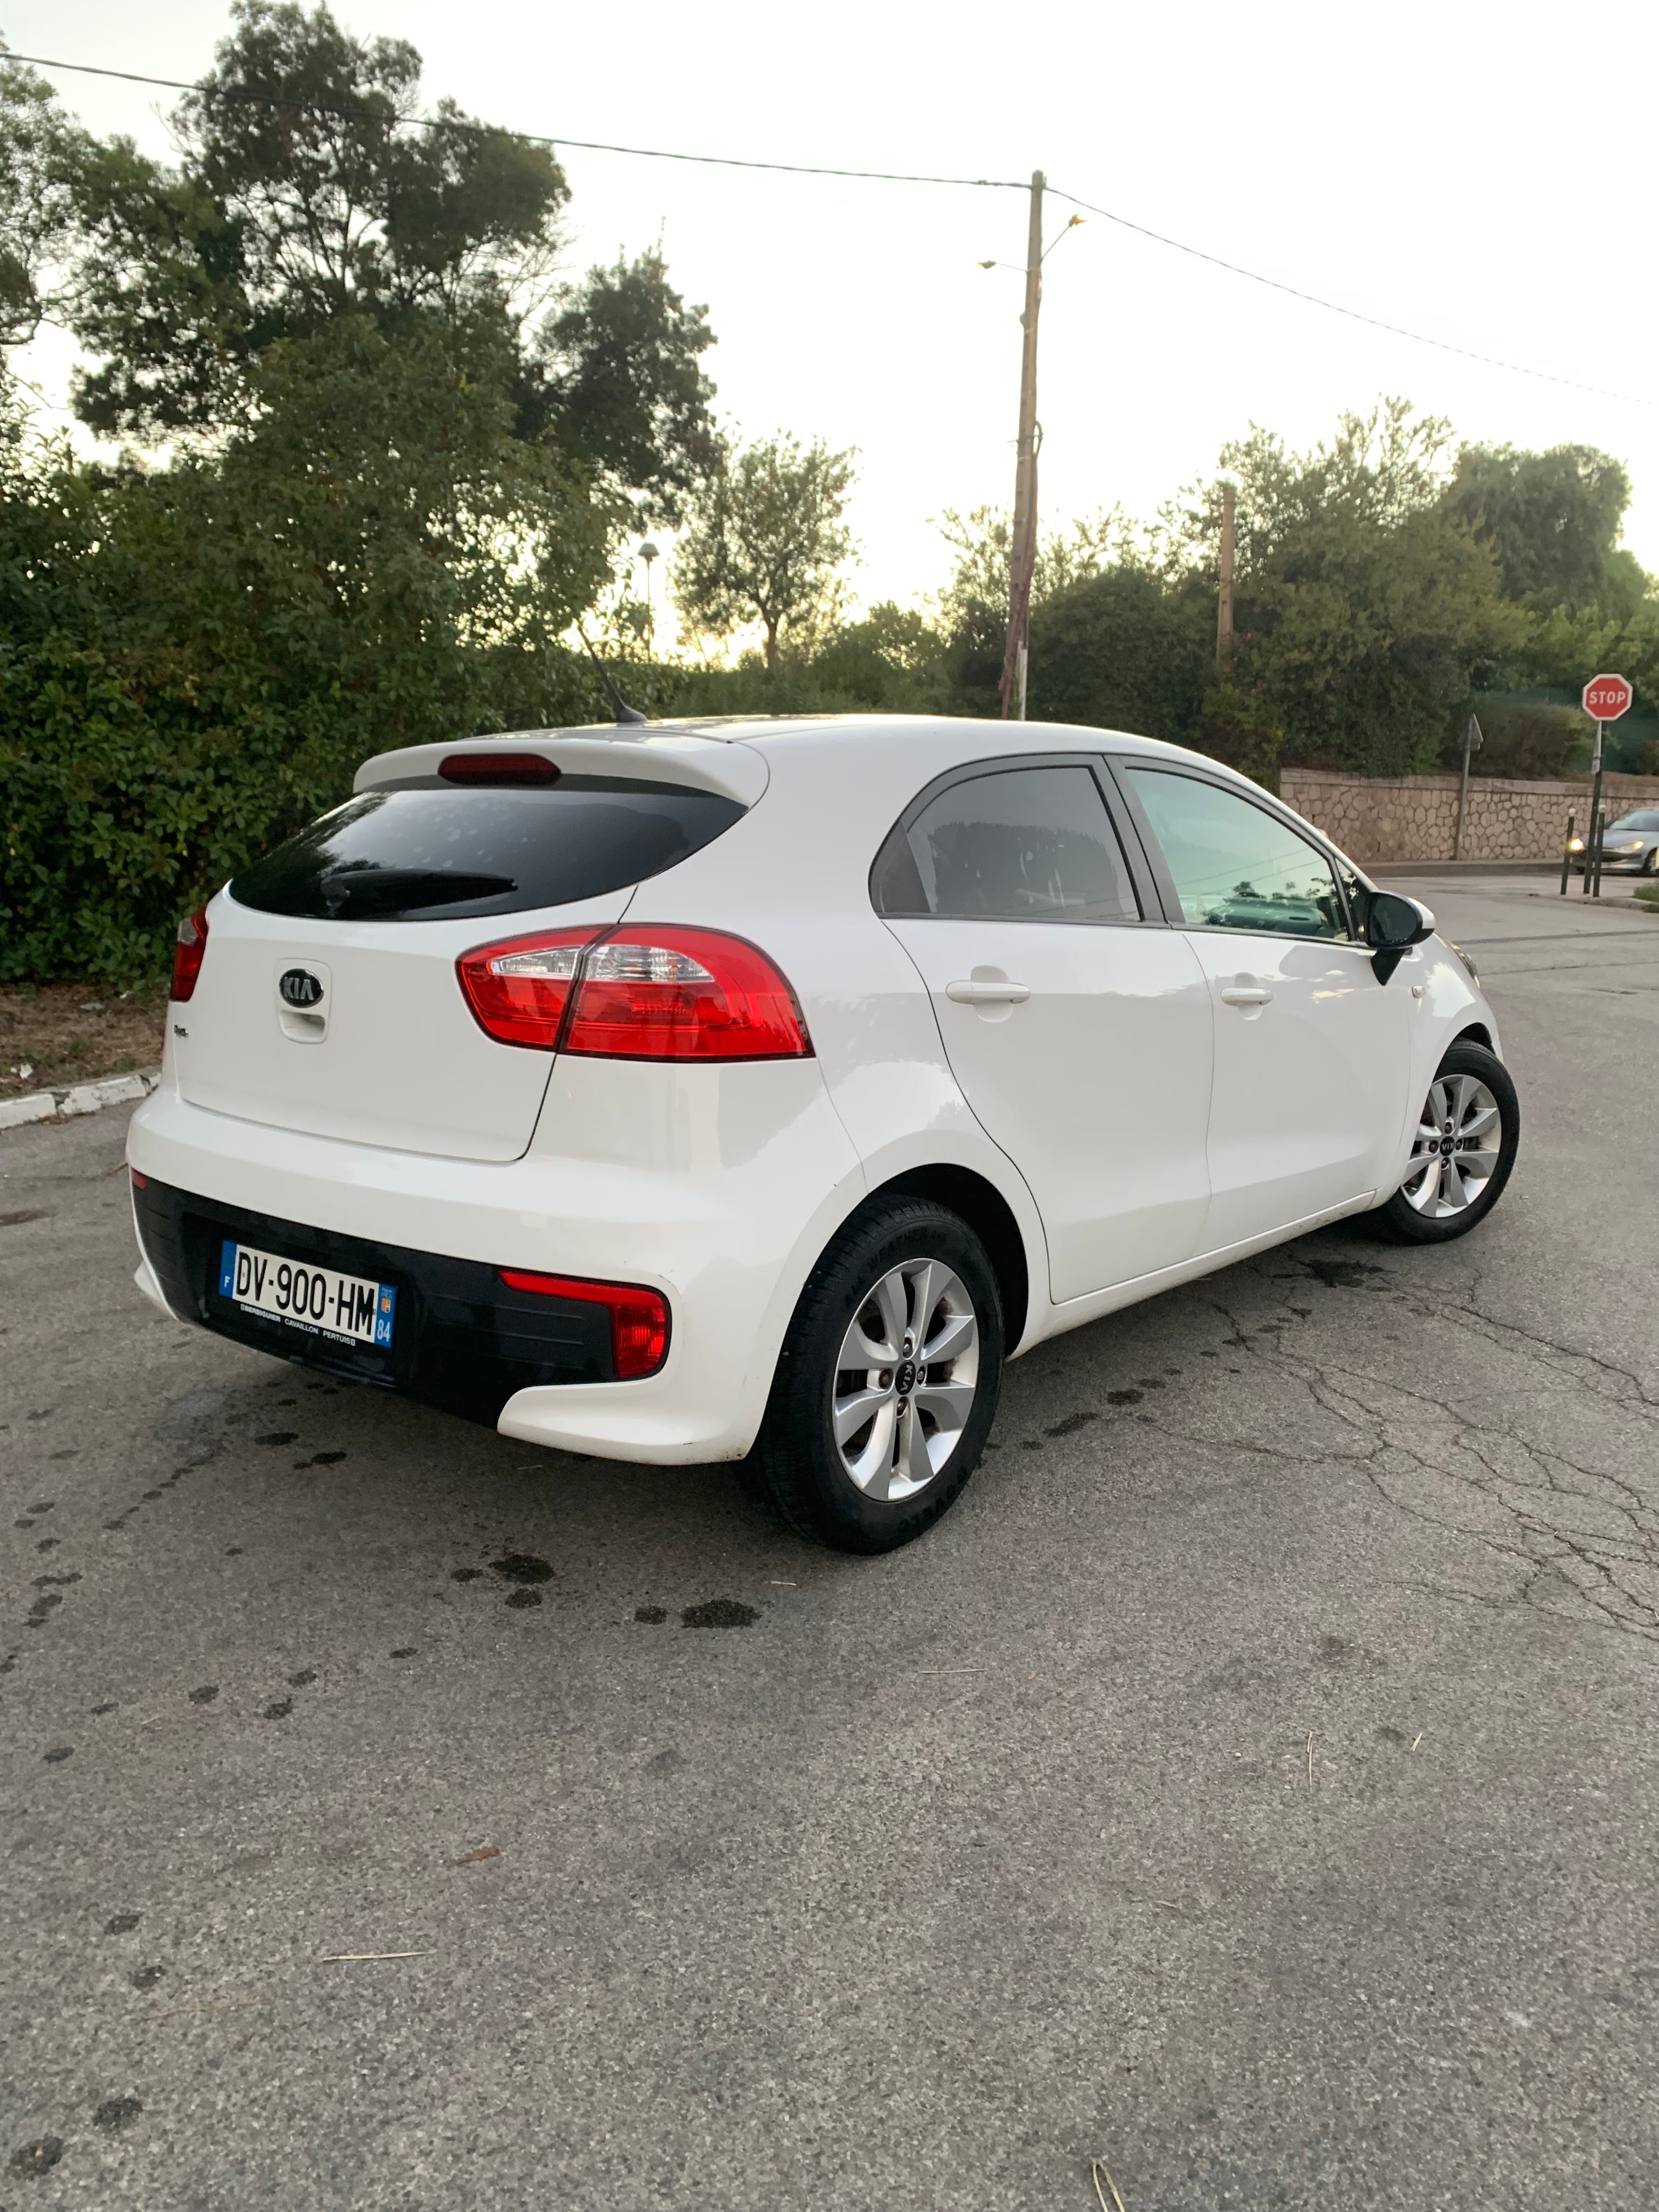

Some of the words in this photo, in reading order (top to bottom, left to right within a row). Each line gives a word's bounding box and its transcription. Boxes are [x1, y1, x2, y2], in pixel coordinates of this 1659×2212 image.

[1589, 691, 1626, 704] STOP
[283, 977, 314, 1000] KIA
[1442, 1142, 1454, 1150] KIA
[223, 1276, 230, 1288] F
[236, 1251, 375, 1336] DV-900-HM
[284, 1318, 318, 1334] CAVAILLON
[323, 1330, 351, 1345] PERTUIS
[377, 1319, 390, 1342] 84
[900, 1364, 913, 1391] KIA
